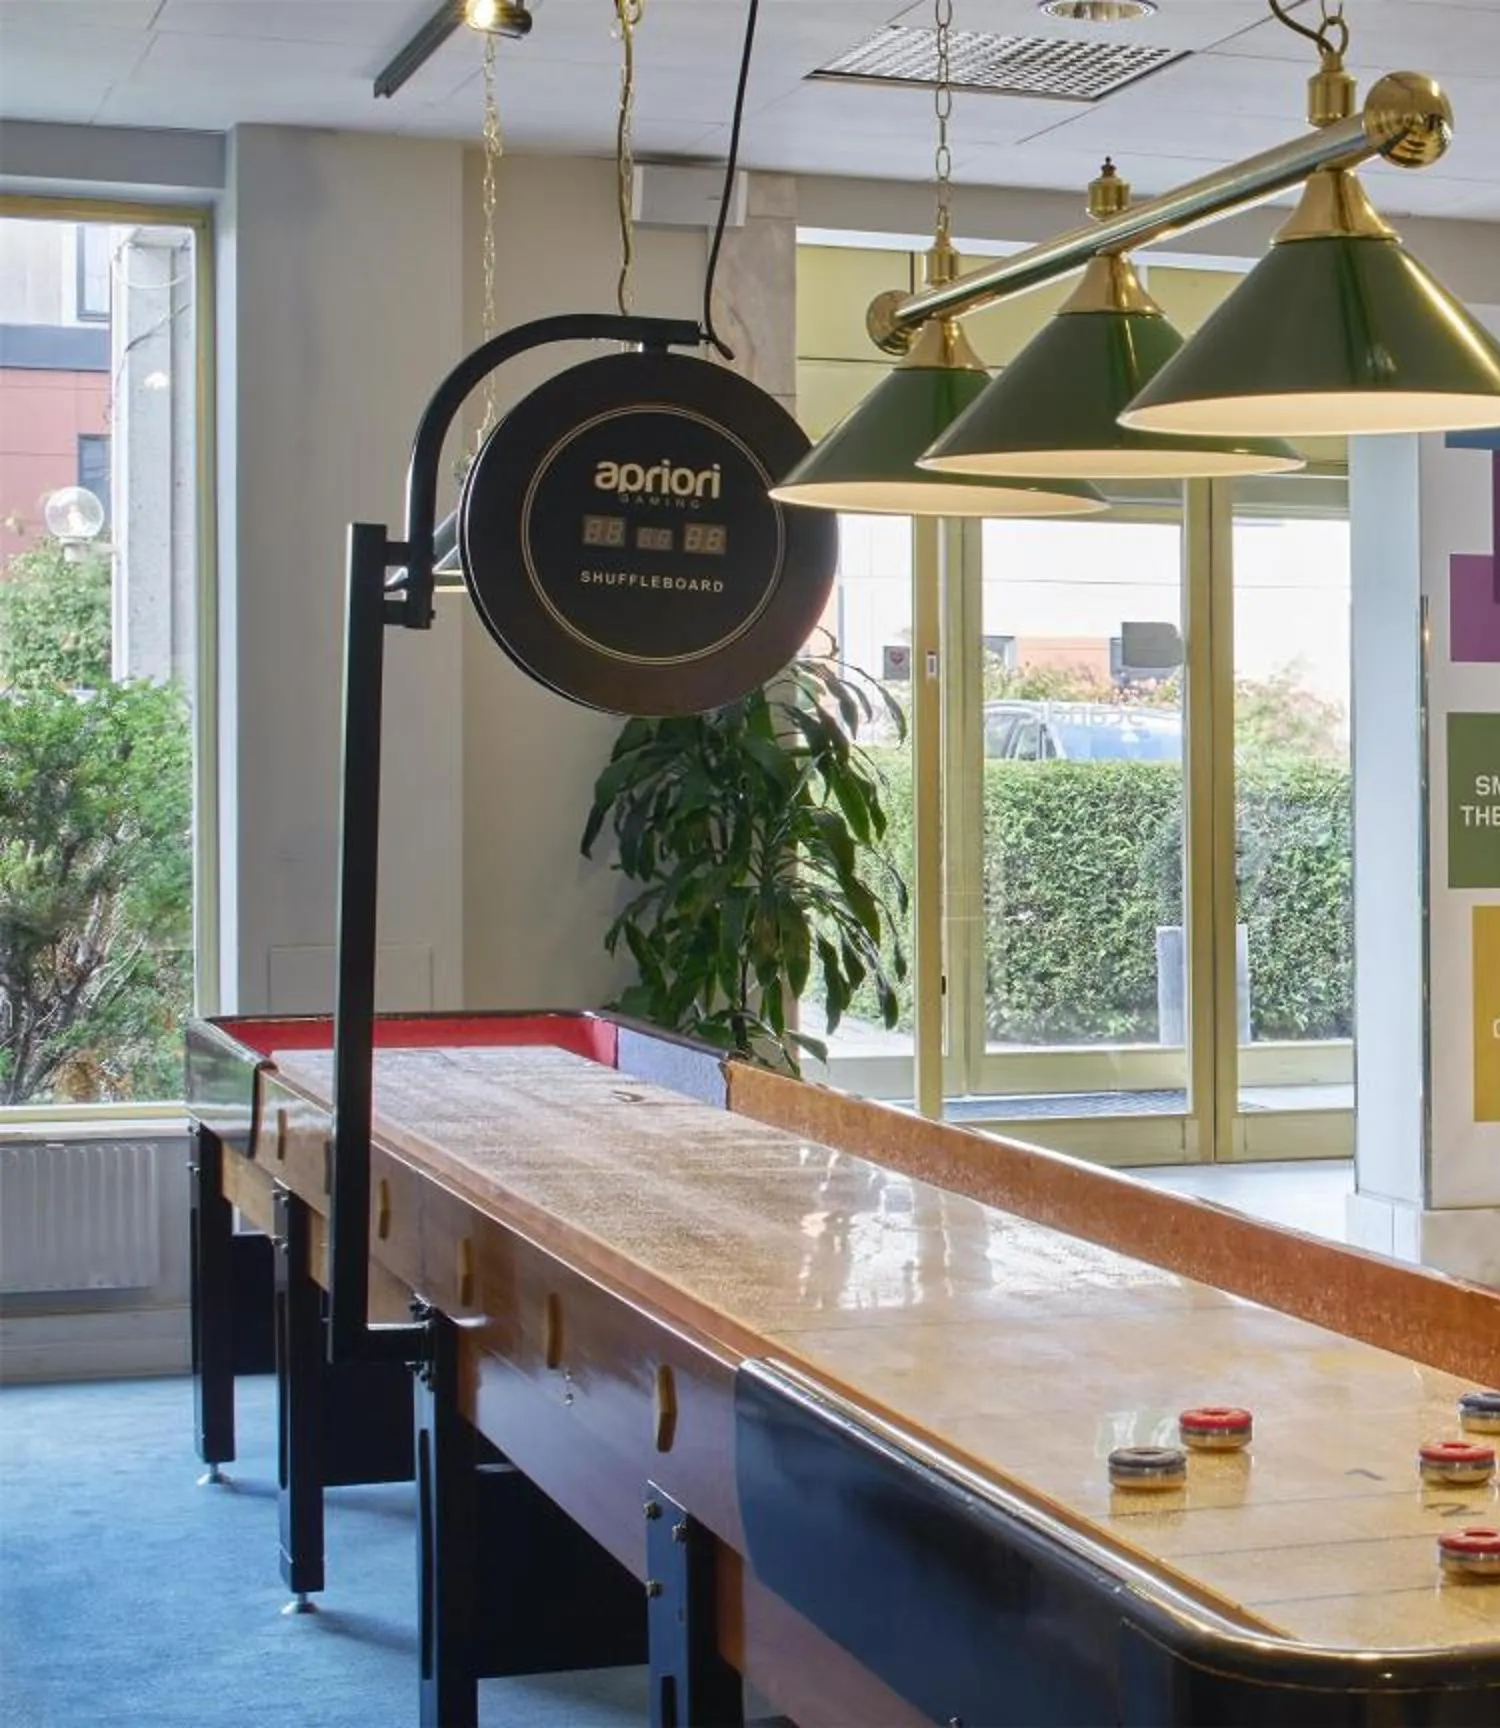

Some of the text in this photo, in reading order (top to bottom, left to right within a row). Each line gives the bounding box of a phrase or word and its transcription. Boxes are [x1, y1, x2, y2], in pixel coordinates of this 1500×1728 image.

[595, 459, 721, 499] apriori
[620, 493, 701, 509] GAMING
[580, 570, 724, 593] SHUFFLEBOARD
